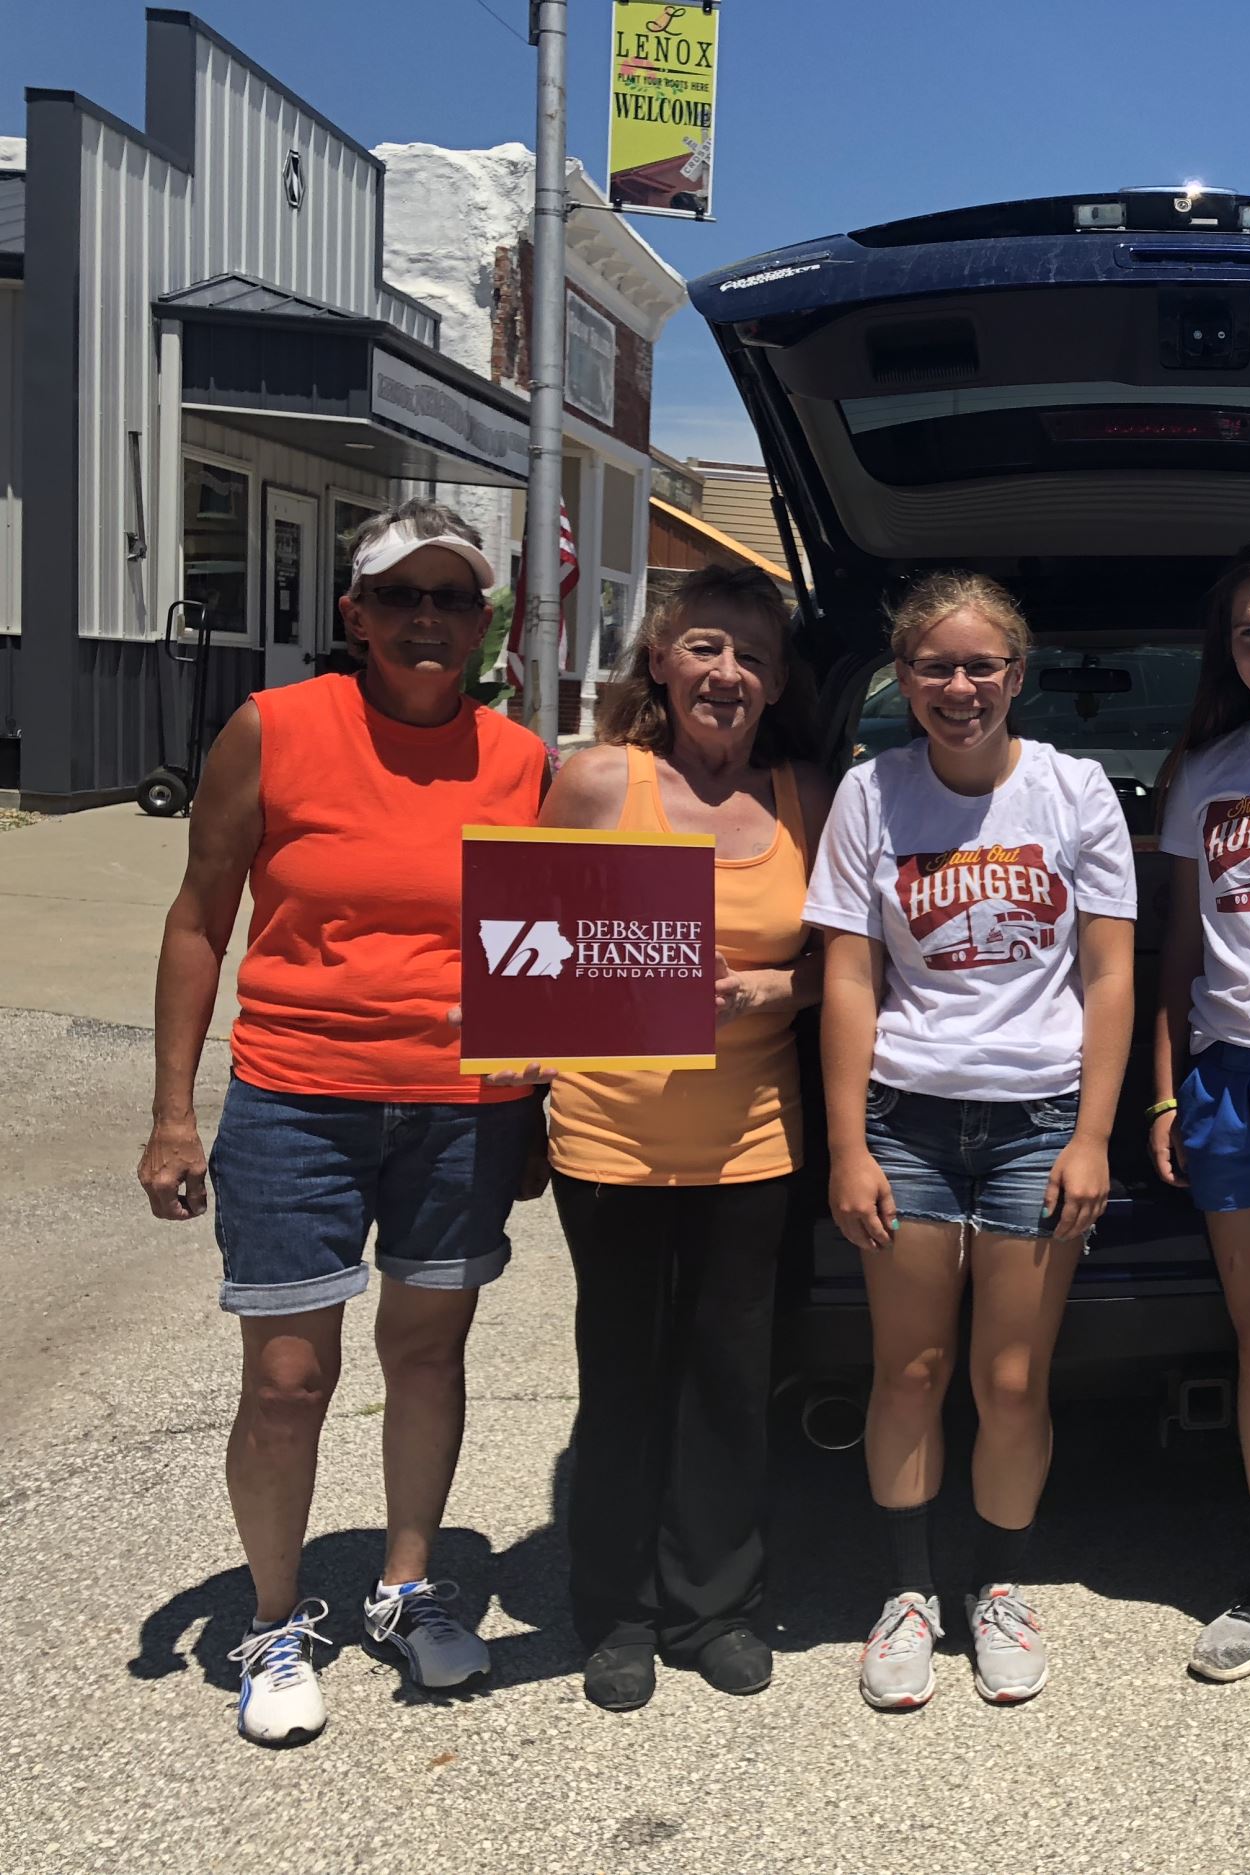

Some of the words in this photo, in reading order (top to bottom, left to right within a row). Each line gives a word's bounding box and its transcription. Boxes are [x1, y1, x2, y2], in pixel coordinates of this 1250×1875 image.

[616, 31, 713, 68] LENOX
[617, 72, 641, 84] PLANT
[643, 75, 662, 86] YOUR
[664, 77, 689, 90] ROOTS
[690, 82, 709, 92] HERE
[613, 91, 712, 128] WELCOME
[987, 844, 1021, 863] Out
[909, 863, 1055, 921] HUNGER
[576, 943, 702, 965] HANSEN
[576, 968, 703, 978] FOUNDATION
